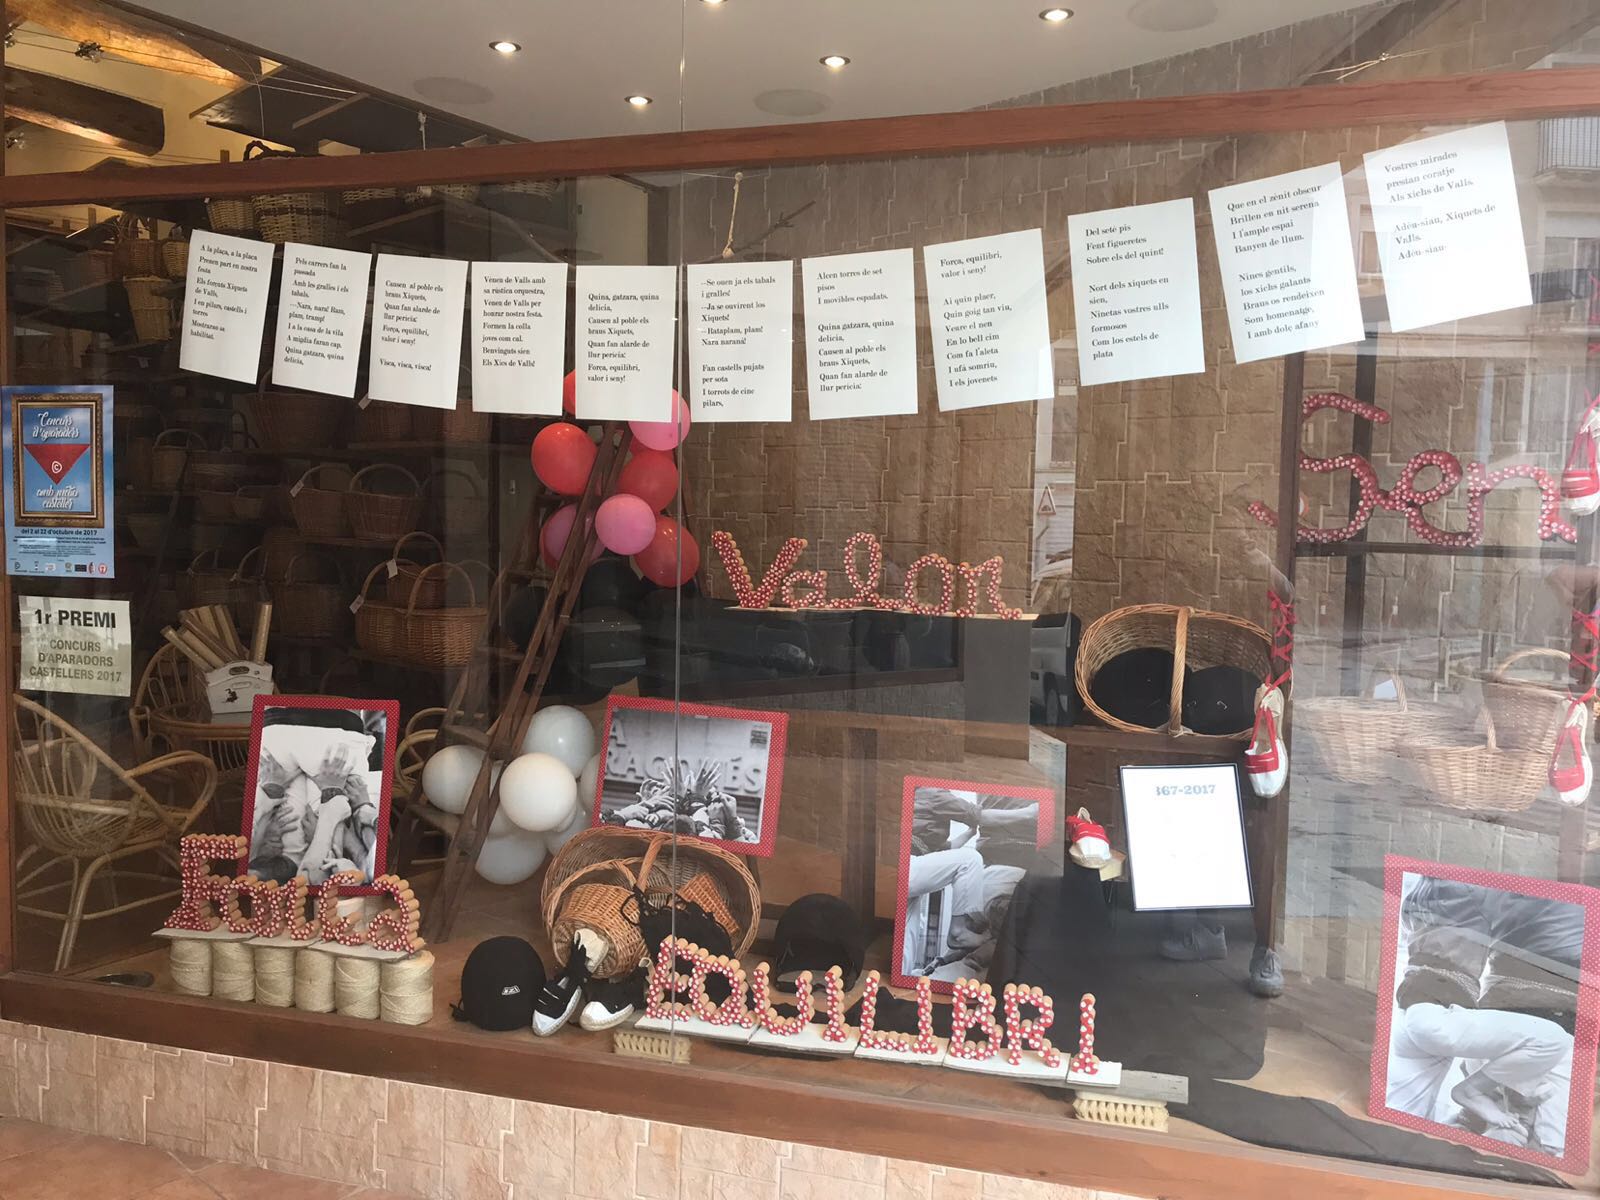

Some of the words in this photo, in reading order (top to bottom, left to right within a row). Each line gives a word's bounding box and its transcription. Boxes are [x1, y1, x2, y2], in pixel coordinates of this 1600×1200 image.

[1230, 213, 1261, 225] Brillen
[1276, 206, 1289, 215] nit
[1086, 242, 1105, 250] Fent
[1106, 237, 1147, 248] figueretes
[1234, 241, 1267, 253] Banyen
[1268, 237, 1279, 246] de
[939, 258, 964, 267] Força,
[965, 250, 1002, 264] equilibri,
[1086, 255, 1109, 264] Sobre
[1110, 252, 1123, 261] els
[1124, 250, 1137, 259] del
[816, 271, 838, 279] Alcen
[1238, 271, 1263, 282] Nines
[816, 283, 835, 293] pisos
[1108, 281, 1126, 290] dels
[1127, 278, 1157, 288] xiquets
[1240, 288, 1253, 296] los
[1254, 282, 1277, 293] xichs
[1279, 276, 1311, 290] galants
[943, 297, 952, 305] Ai
[954, 295, 972, 306] quin
[943, 310, 963, 320] Quin
[964, 307, 981, 318] goig
[1123, 306, 1151, 314] vostres
[1152, 301, 1168, 310] ulls
[817, 323, 840, 332] Quina
[841, 322, 870, 330] gatzara,
[871, 320, 894, 328] quina
[968, 321, 976, 329] el
[1243, 316, 1263, 325] Som
[1090, 323, 1127, 333] formosos
[946, 338, 957, 346] En
[958, 336, 967, 344] lo
[968, 334, 983, 343] bell
[1111, 336, 1124, 344] los
[1124, 332, 1147, 342] estels
[1148, 331, 1159, 339] de
[964, 349, 973, 357] fa
[974, 347, 998, 356] l'aleta
[1092, 350, 1113, 360] plata
[840, 357, 870, 366] Xiquets,
[818, 372, 838, 382] Quan
[854, 369, 877, 378] alarde
[35, 609, 52, 625] 1r
[58, 610, 116, 628] PREMI
[50, 640, 101, 652] CONCURS
[38, 652, 113, 667] D'APARADORS
[30, 666, 94, 680] CASTELLERS
[96, 670, 122, 682] 2017
[645, 934, 1098, 1075] EQUILIBRI
